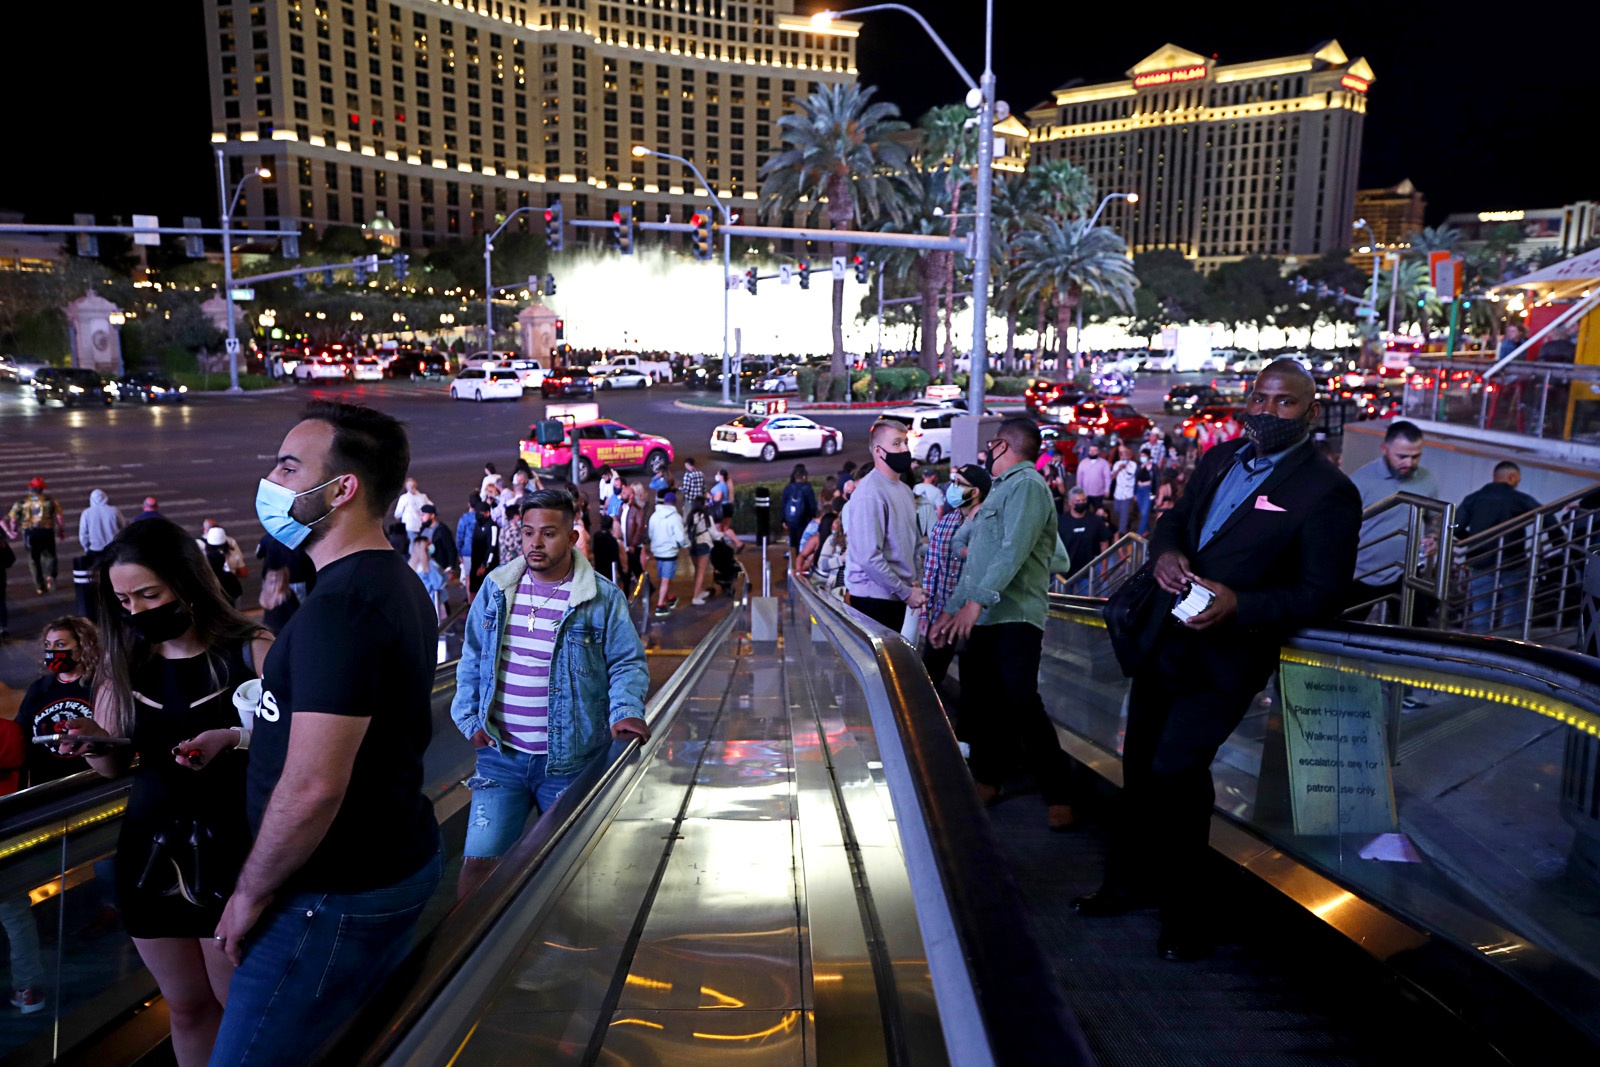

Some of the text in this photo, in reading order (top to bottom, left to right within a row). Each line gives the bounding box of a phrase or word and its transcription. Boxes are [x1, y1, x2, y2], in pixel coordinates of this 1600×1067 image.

[1304, 681, 1358, 693] Welcome to
[34, 702, 64, 725] AGAINST
[65, 701, 80, 710] THE
[1294, 705, 1372, 719] Planet Holywood.
[1304, 731, 1367, 743] Walkways and
[1299, 757, 1345, 768] escalatos
[1365, 761, 1378, 769] for
[1306, 784, 1335, 793] patron
[1356, 786, 1376, 797] only.
